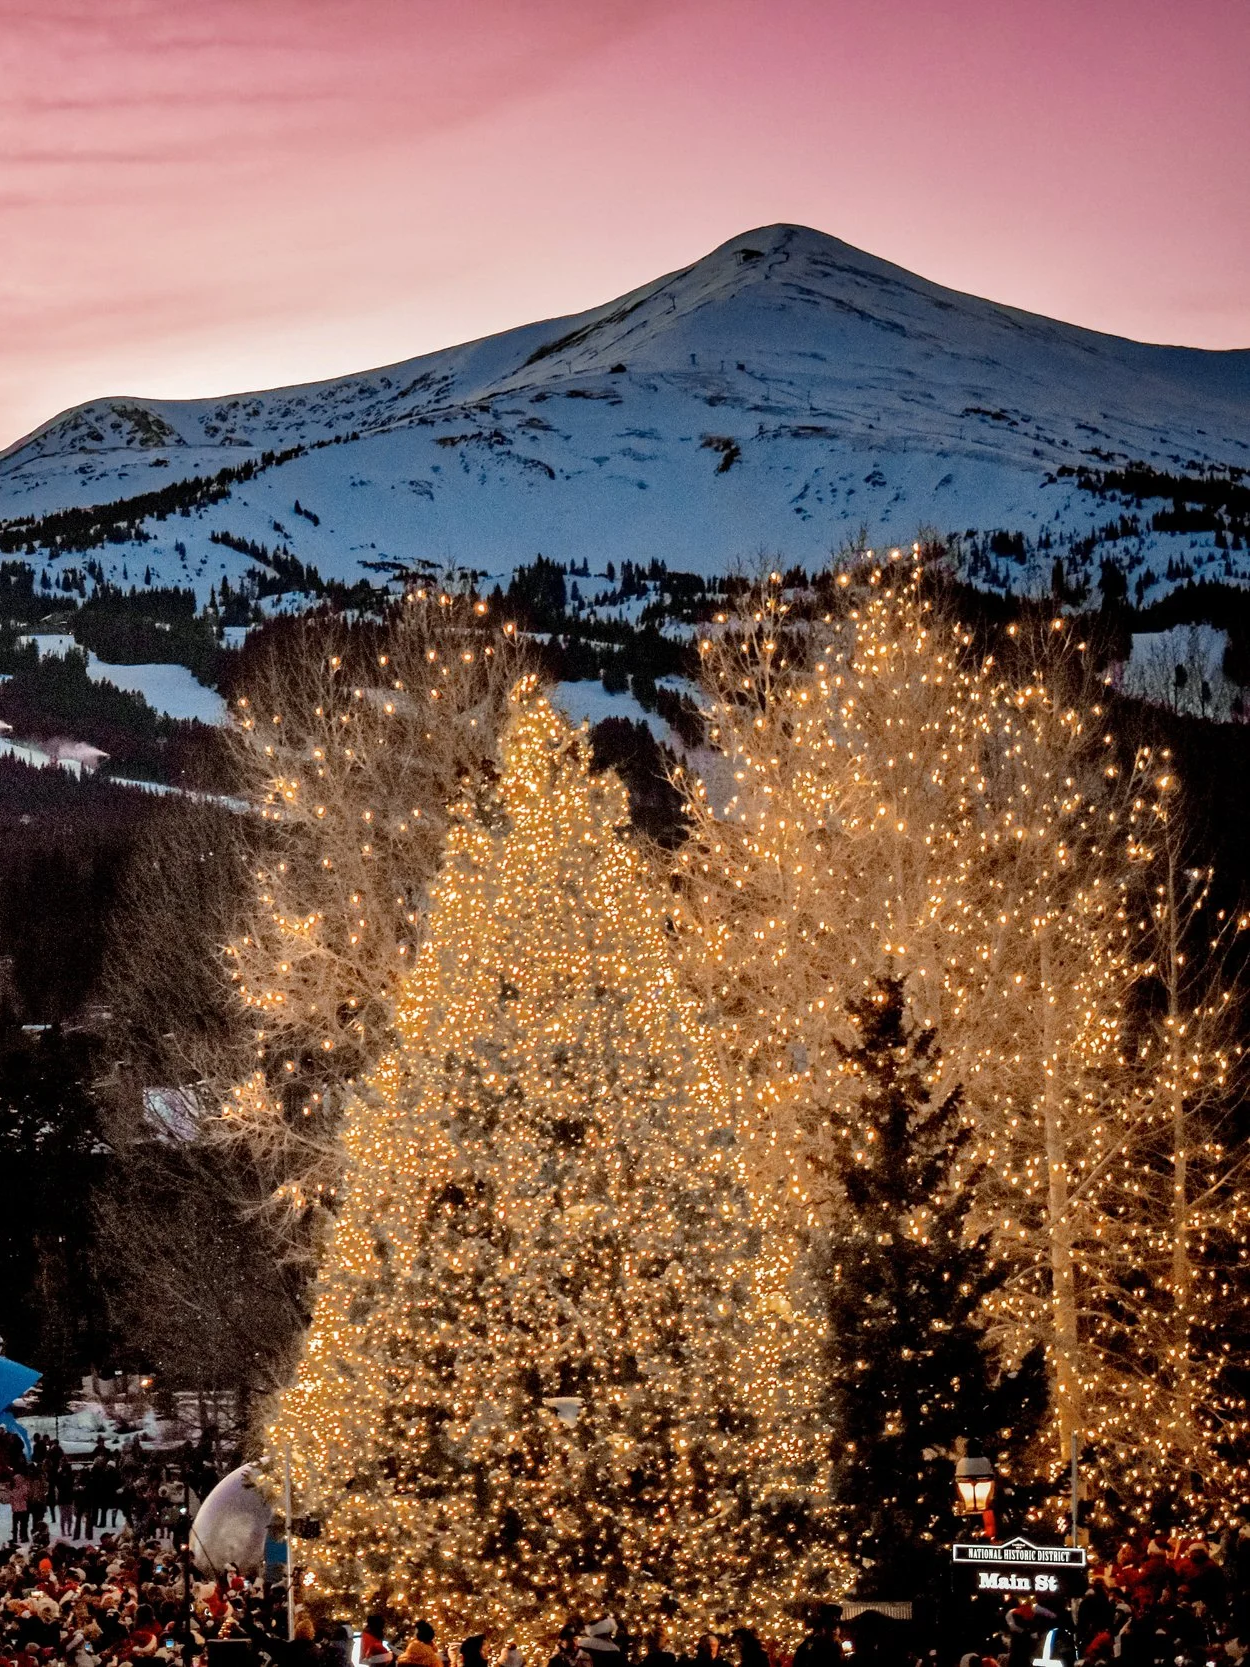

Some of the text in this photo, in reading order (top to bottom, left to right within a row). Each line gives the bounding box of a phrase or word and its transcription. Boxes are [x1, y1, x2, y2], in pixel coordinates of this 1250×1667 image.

[968, 1548, 1070, 1562] NATIONAL HISTORIC DISTRICT
[978, 1572, 1058, 1591] Main St
